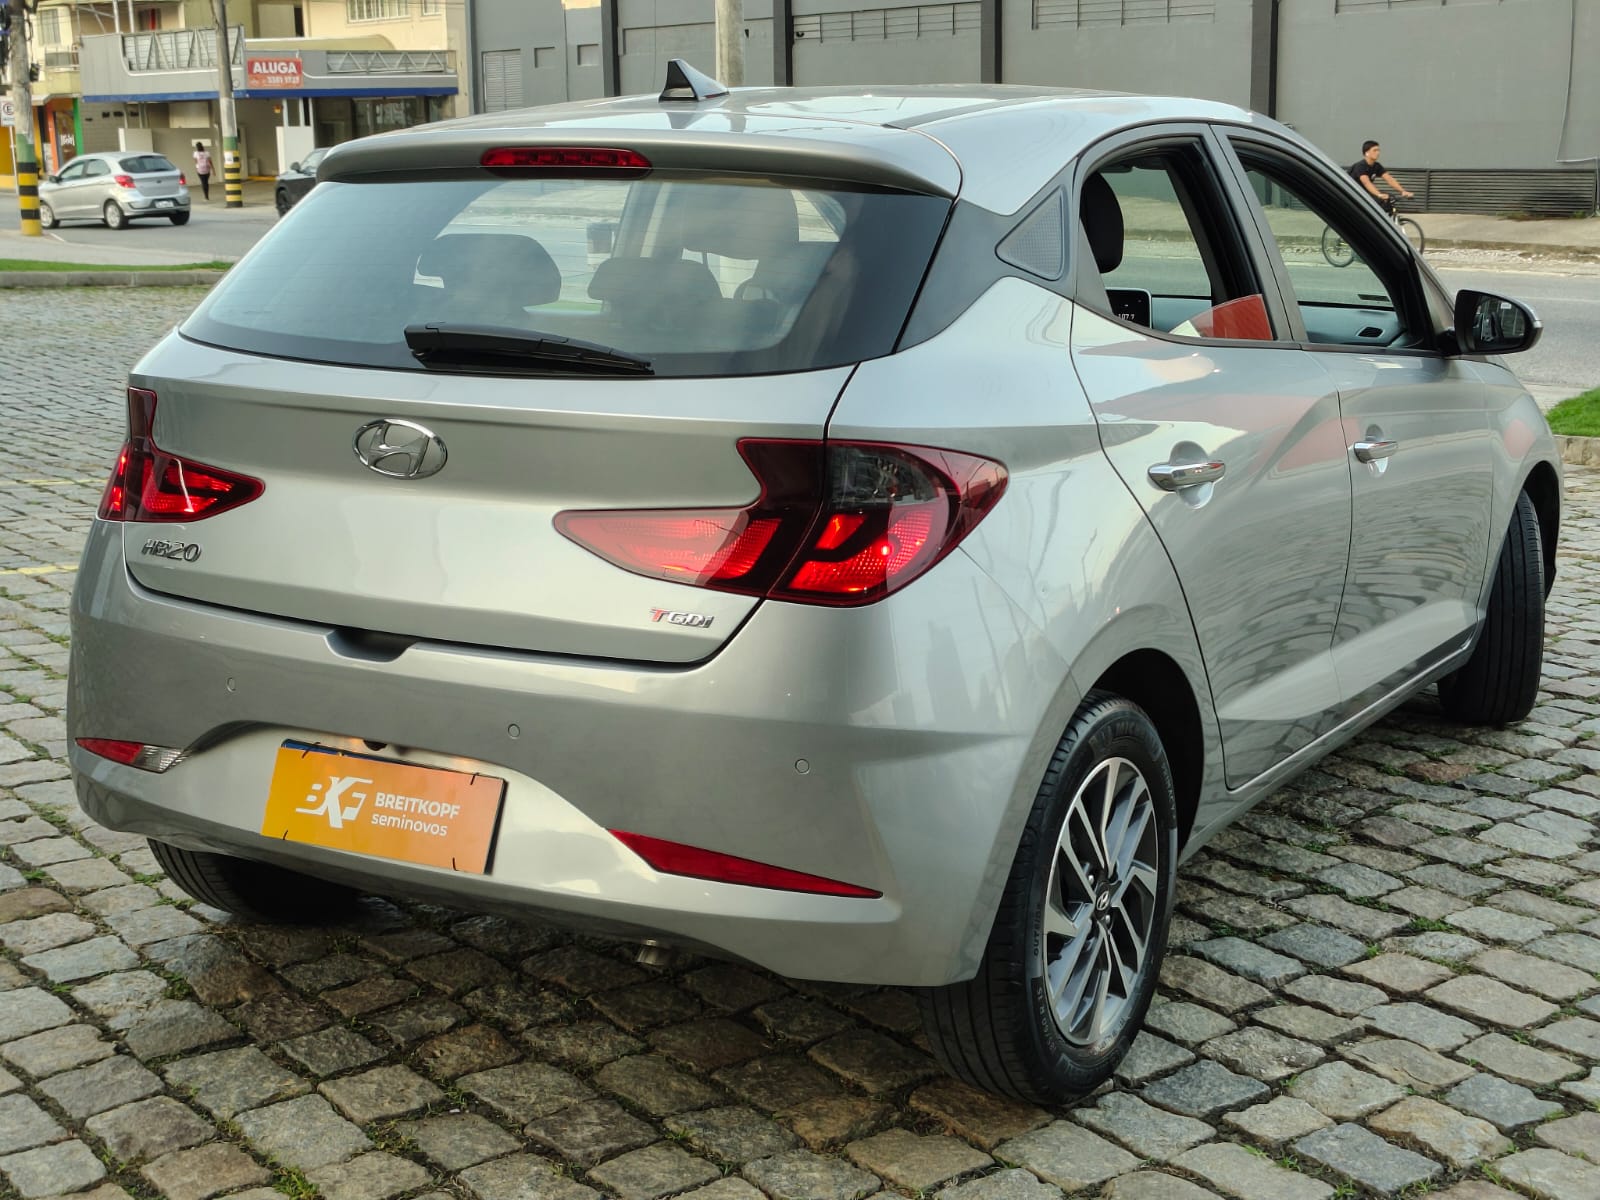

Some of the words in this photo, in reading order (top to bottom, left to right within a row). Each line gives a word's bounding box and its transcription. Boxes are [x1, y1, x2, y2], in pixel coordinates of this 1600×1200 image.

[253, 61, 298, 74] ALUGA
[6, 105, 13, 113] E
[141, 539, 201, 562] HB20
[374, 791, 461, 819] BREITKOPF
[371, 812, 449, 837] seminovos
